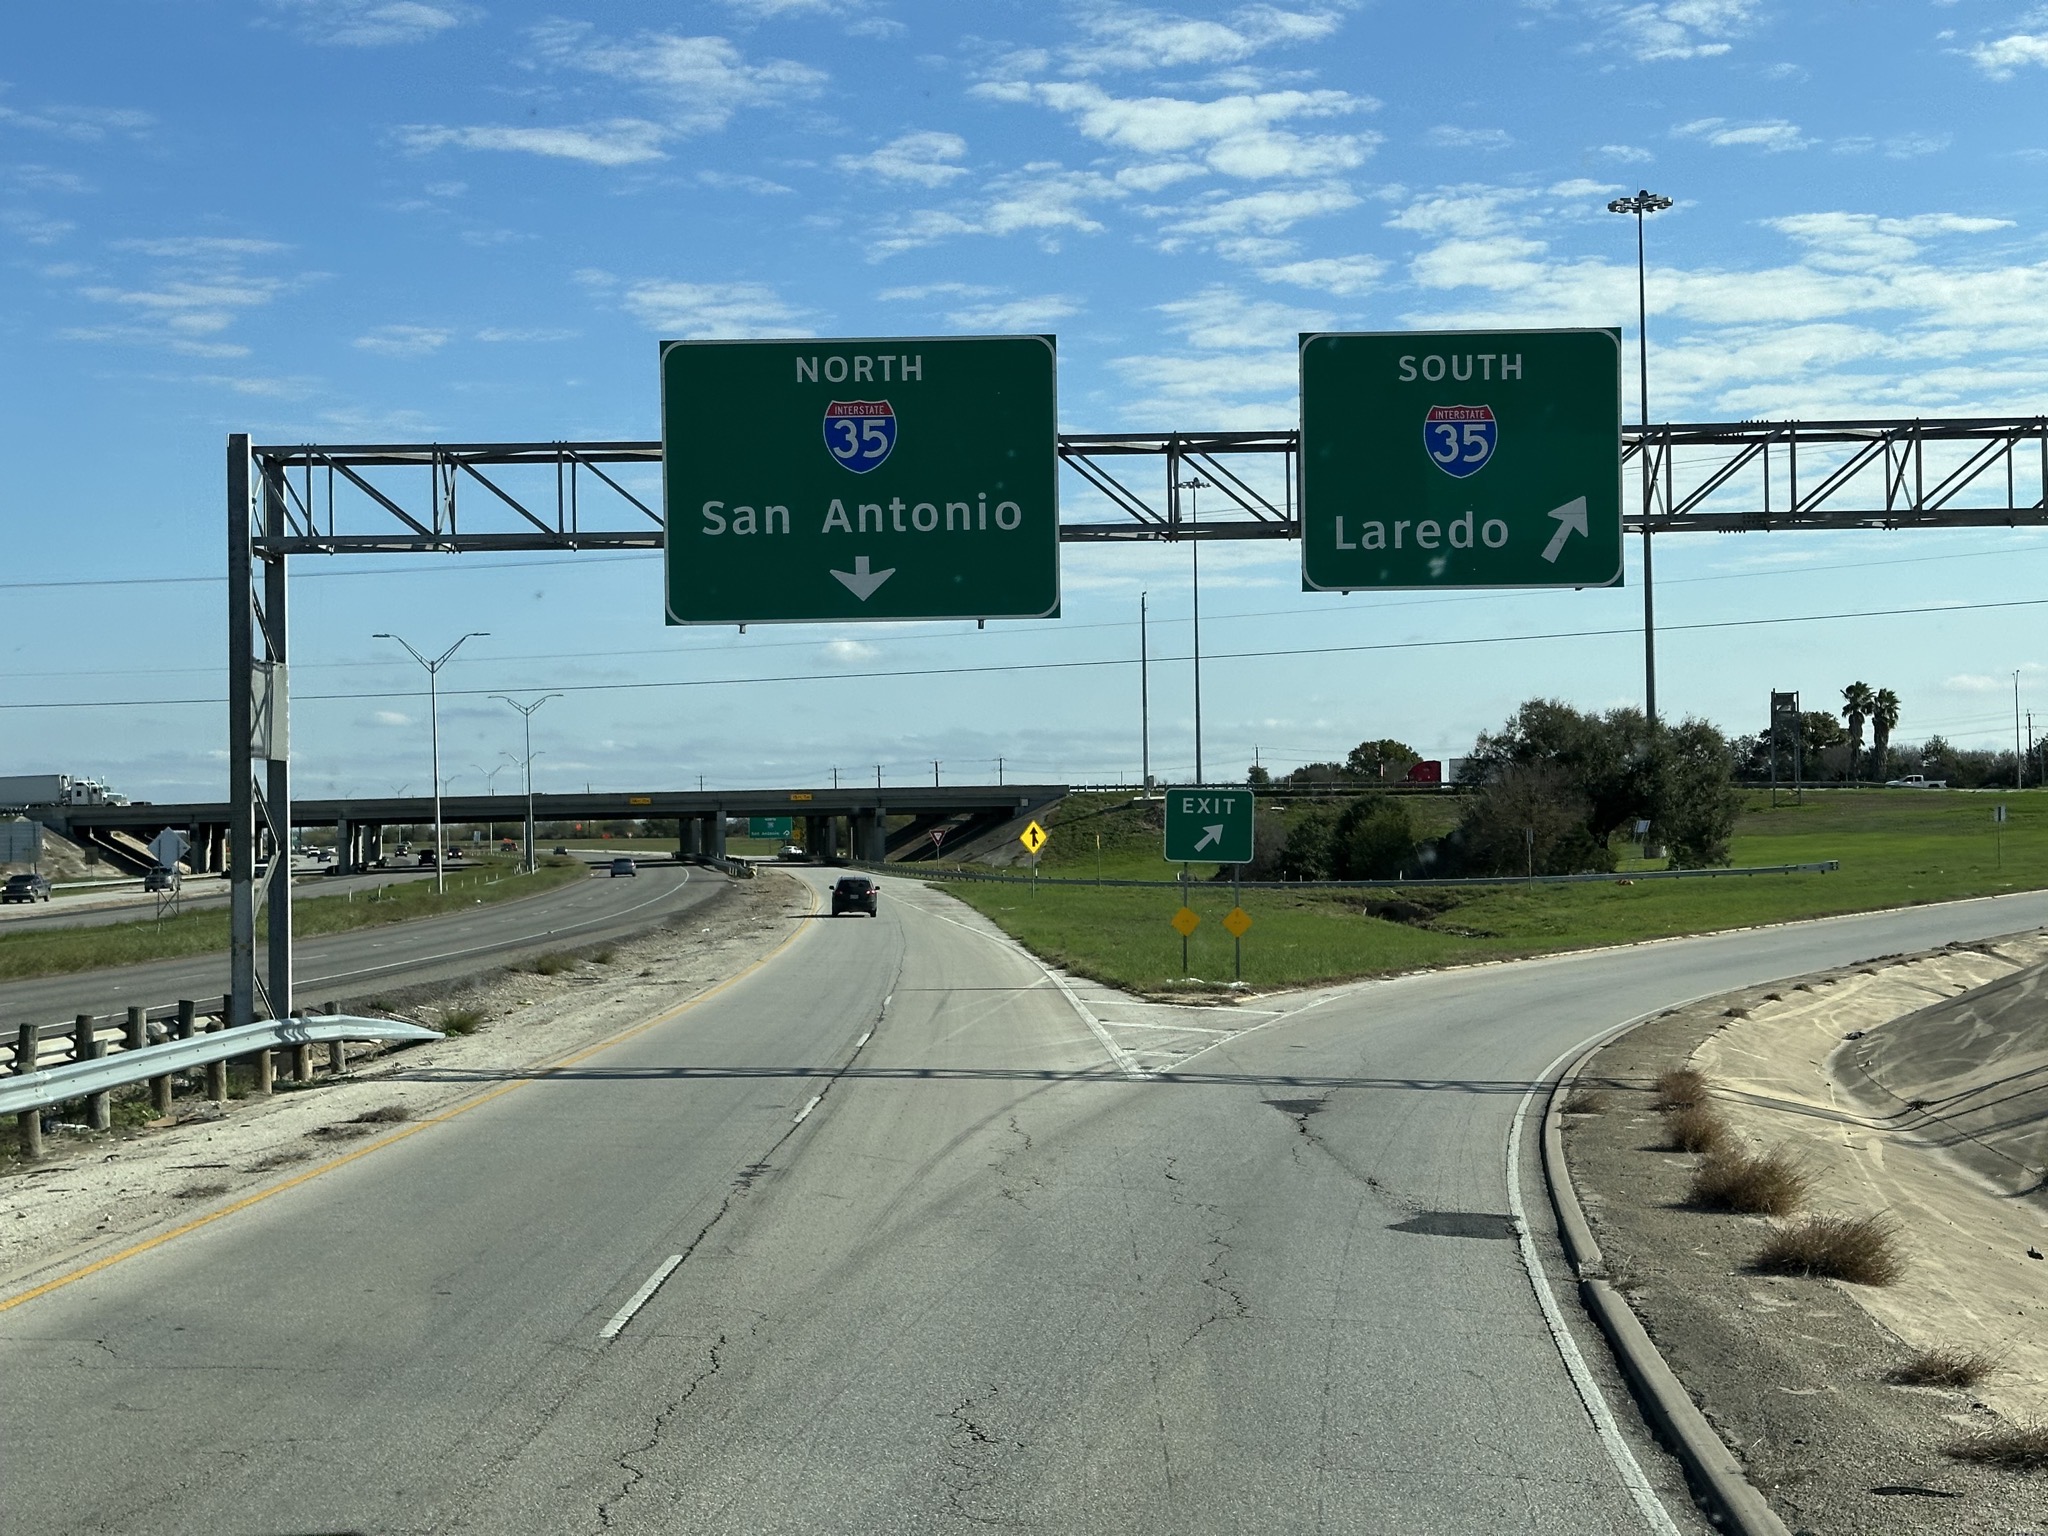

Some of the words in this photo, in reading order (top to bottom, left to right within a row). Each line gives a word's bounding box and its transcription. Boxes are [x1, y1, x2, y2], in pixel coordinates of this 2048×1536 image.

[796, 355, 923, 383] NORTH
[1398, 353, 1522, 382] SOUTH
[834, 405, 885, 415] INTERSTATE
[1435, 410, 1486, 420] INTERSTATE
[833, 419, 888, 459] 35
[1433, 423, 1489, 463] 35
[701, 500, 791, 536] San
[821, 492, 1022, 535] Antonio
[1335, 510, 1509, 550] Laredo
[1182, 797, 1236, 815] EXIT
